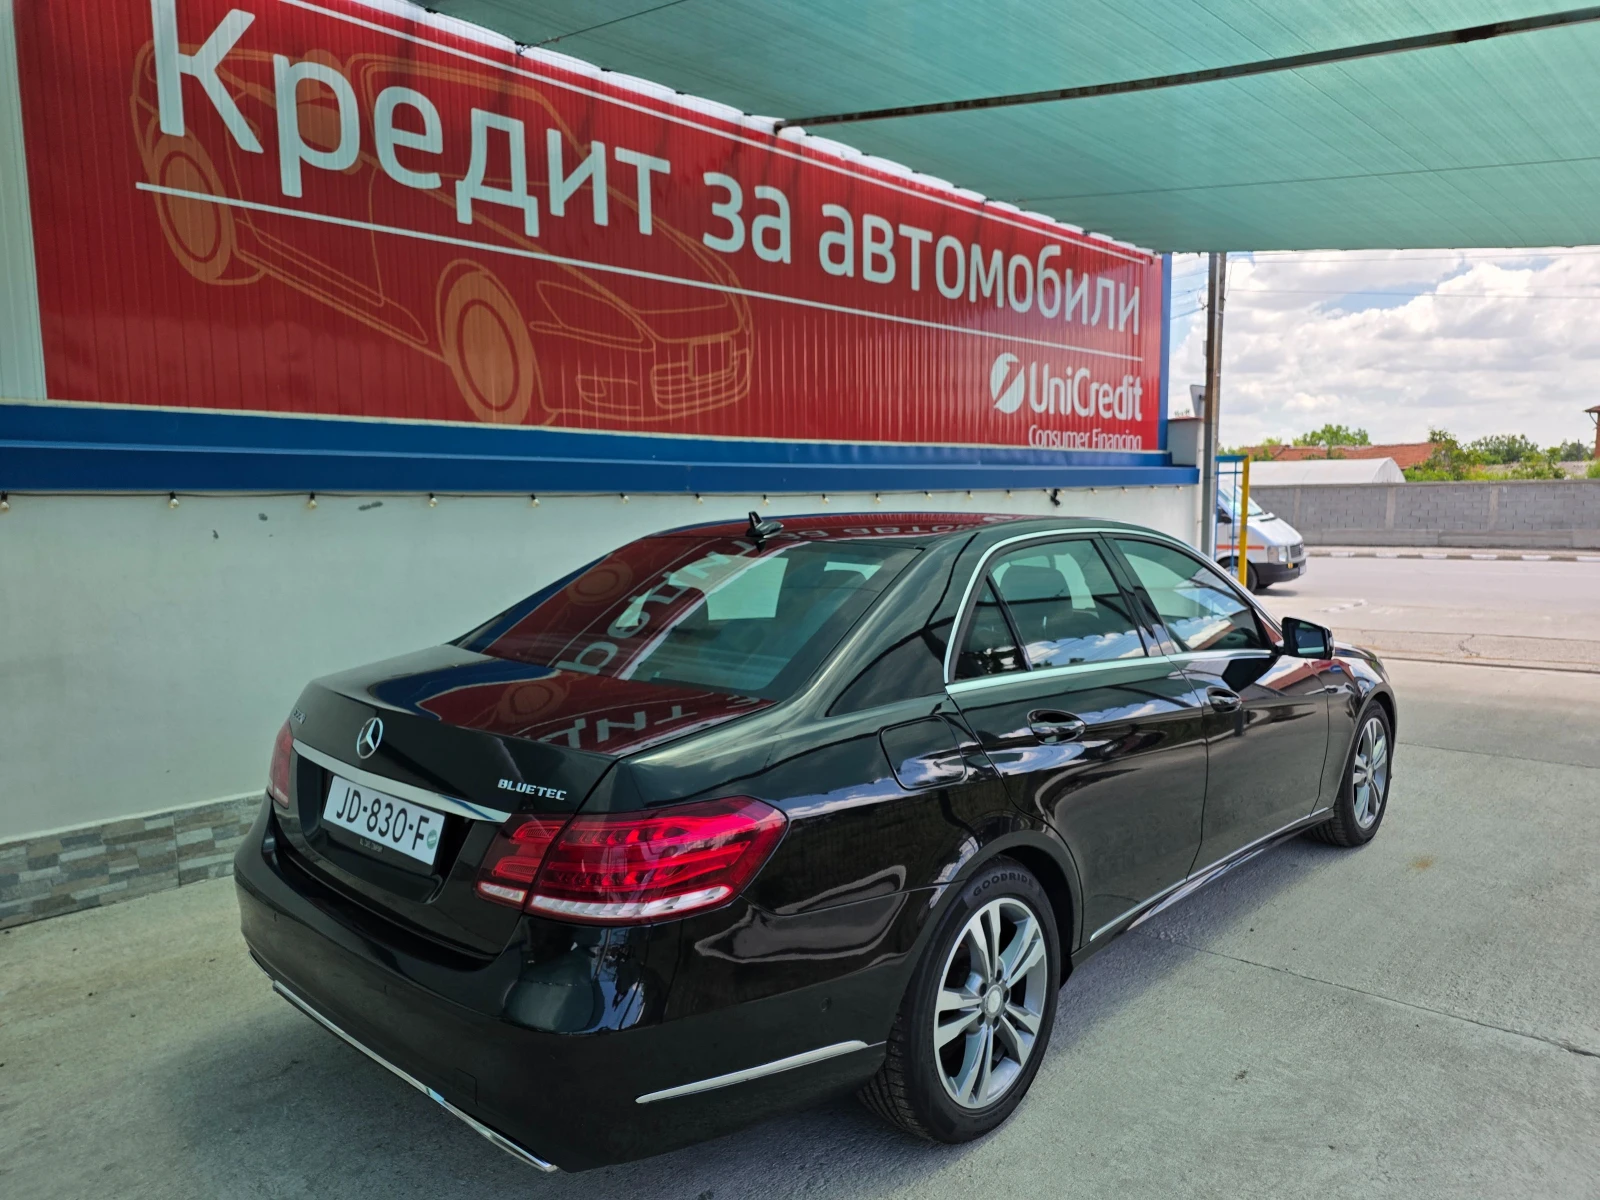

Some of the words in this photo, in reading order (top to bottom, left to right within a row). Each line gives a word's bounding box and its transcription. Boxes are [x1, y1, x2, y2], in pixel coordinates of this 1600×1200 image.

[150, 0, 671, 237] Кредит
[702, 171, 791, 264] за
[818, 203, 1140, 335] автомобили
[1029, 361, 1143, 421] UniCredit
[1028, 424, 1089, 449] Consumer
[335, 786, 430, 851] JD-830-F
[497, 778, 567, 801] BLUETEC
